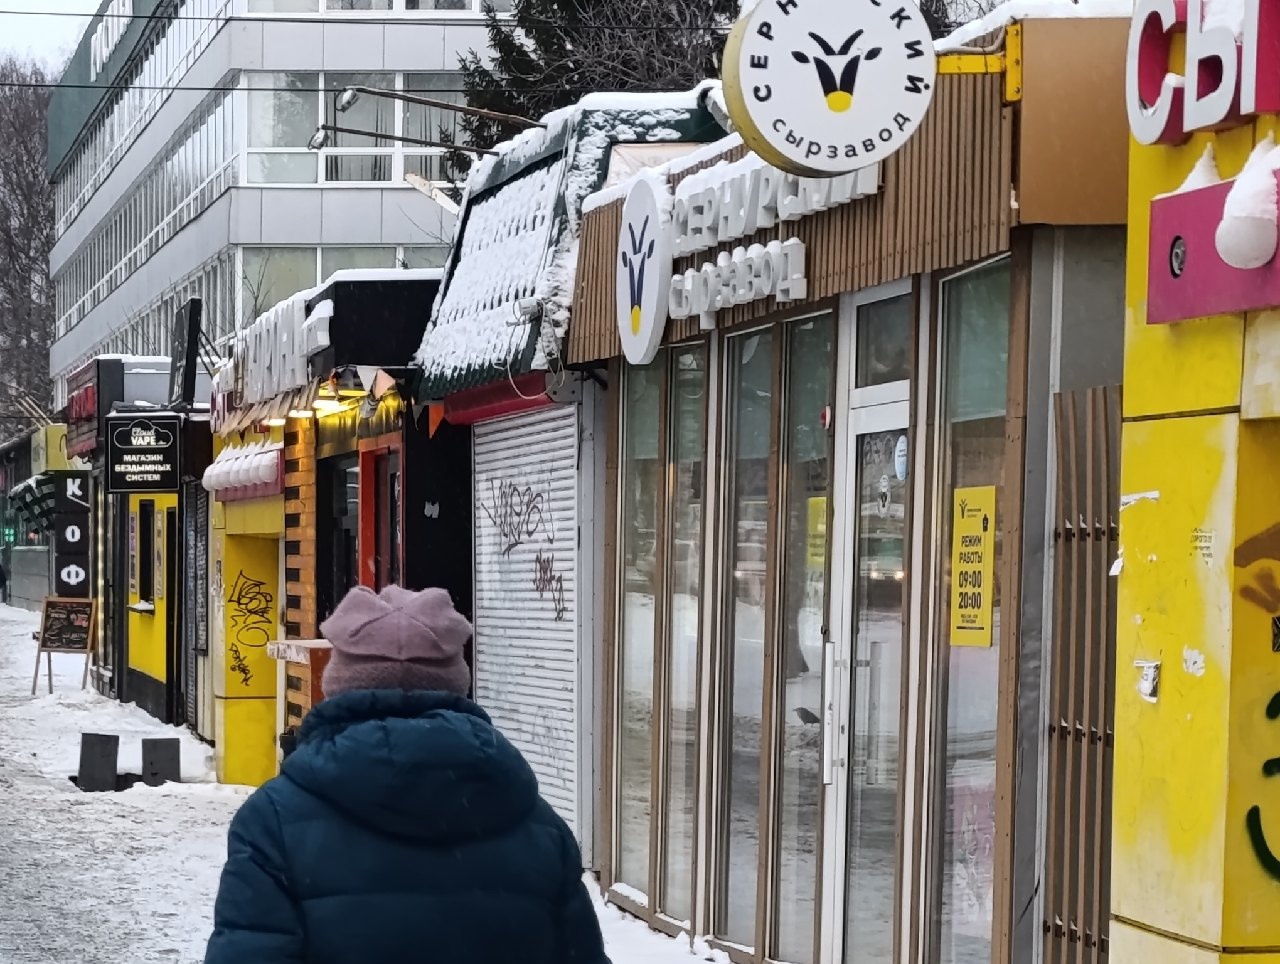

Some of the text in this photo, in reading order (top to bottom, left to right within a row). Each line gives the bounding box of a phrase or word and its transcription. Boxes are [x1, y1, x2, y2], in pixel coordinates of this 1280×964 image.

[750, 0, 930, 102] СЕРНКИЙ
[131, 436, 156, 446] VAPE
[123, 454, 164, 462] МАГАЗИН
[114, 463, 172, 473] БЕЗДЫМНЫХ
[125, 473, 161, 481] СИСТЕМ
[961, 535, 982, 548] РЕЖИМ
[959, 551, 983, 564] РАБОТЫ
[958, 570, 982, 589] 09:00
[958, 592, 982, 610] 20:00
